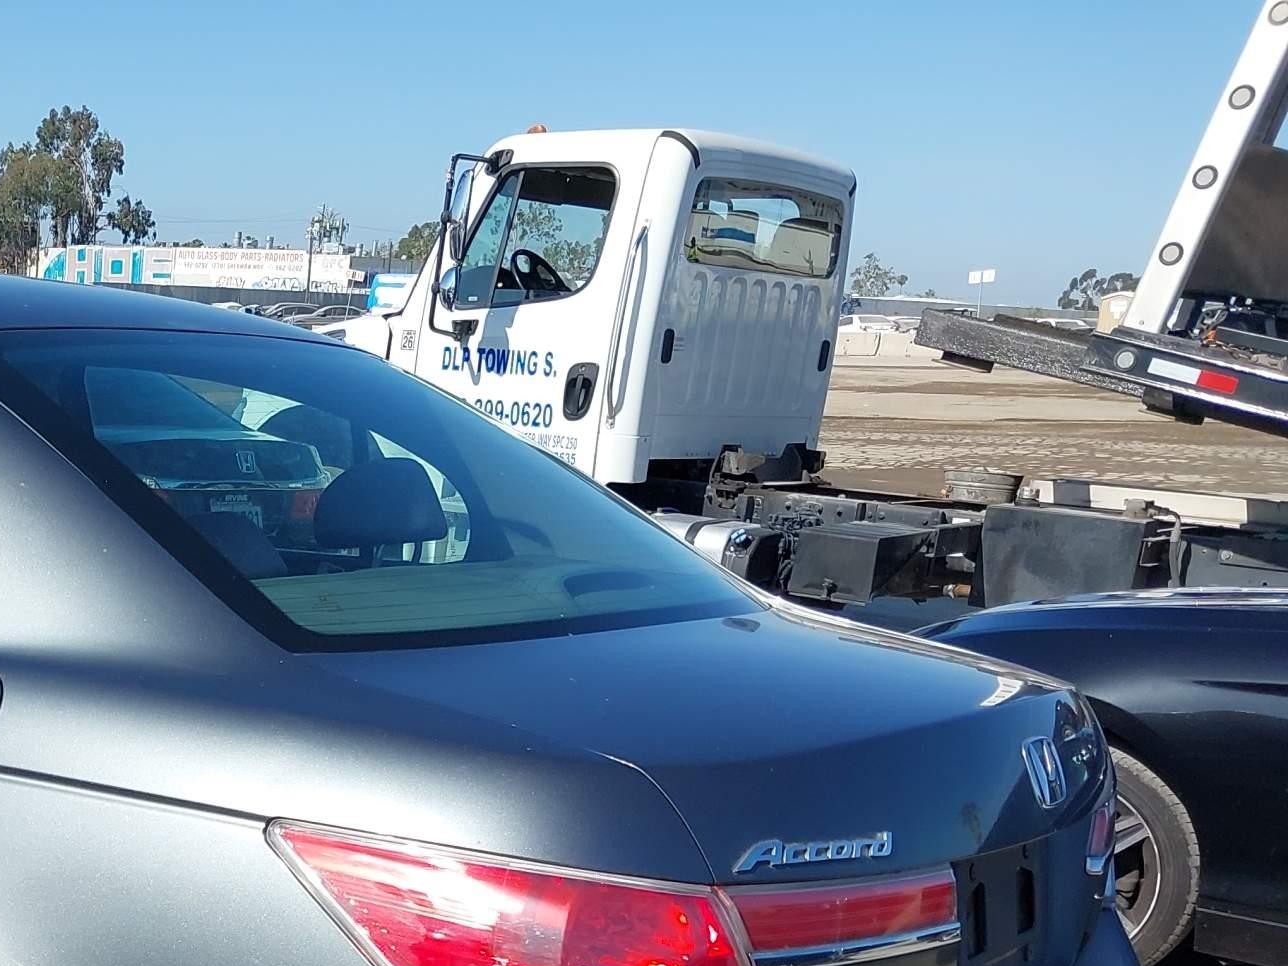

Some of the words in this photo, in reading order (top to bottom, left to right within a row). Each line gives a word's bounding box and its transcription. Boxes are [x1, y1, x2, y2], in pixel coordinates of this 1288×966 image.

[178, 250, 195, 259] AUTO
[402, 335, 414, 348] 26
[442, 346, 470, 371] DLP
[476, 347, 538, 376] TOWING
[543, 351, 557, 377] S.
[733, 831, 893, 873] Accord
